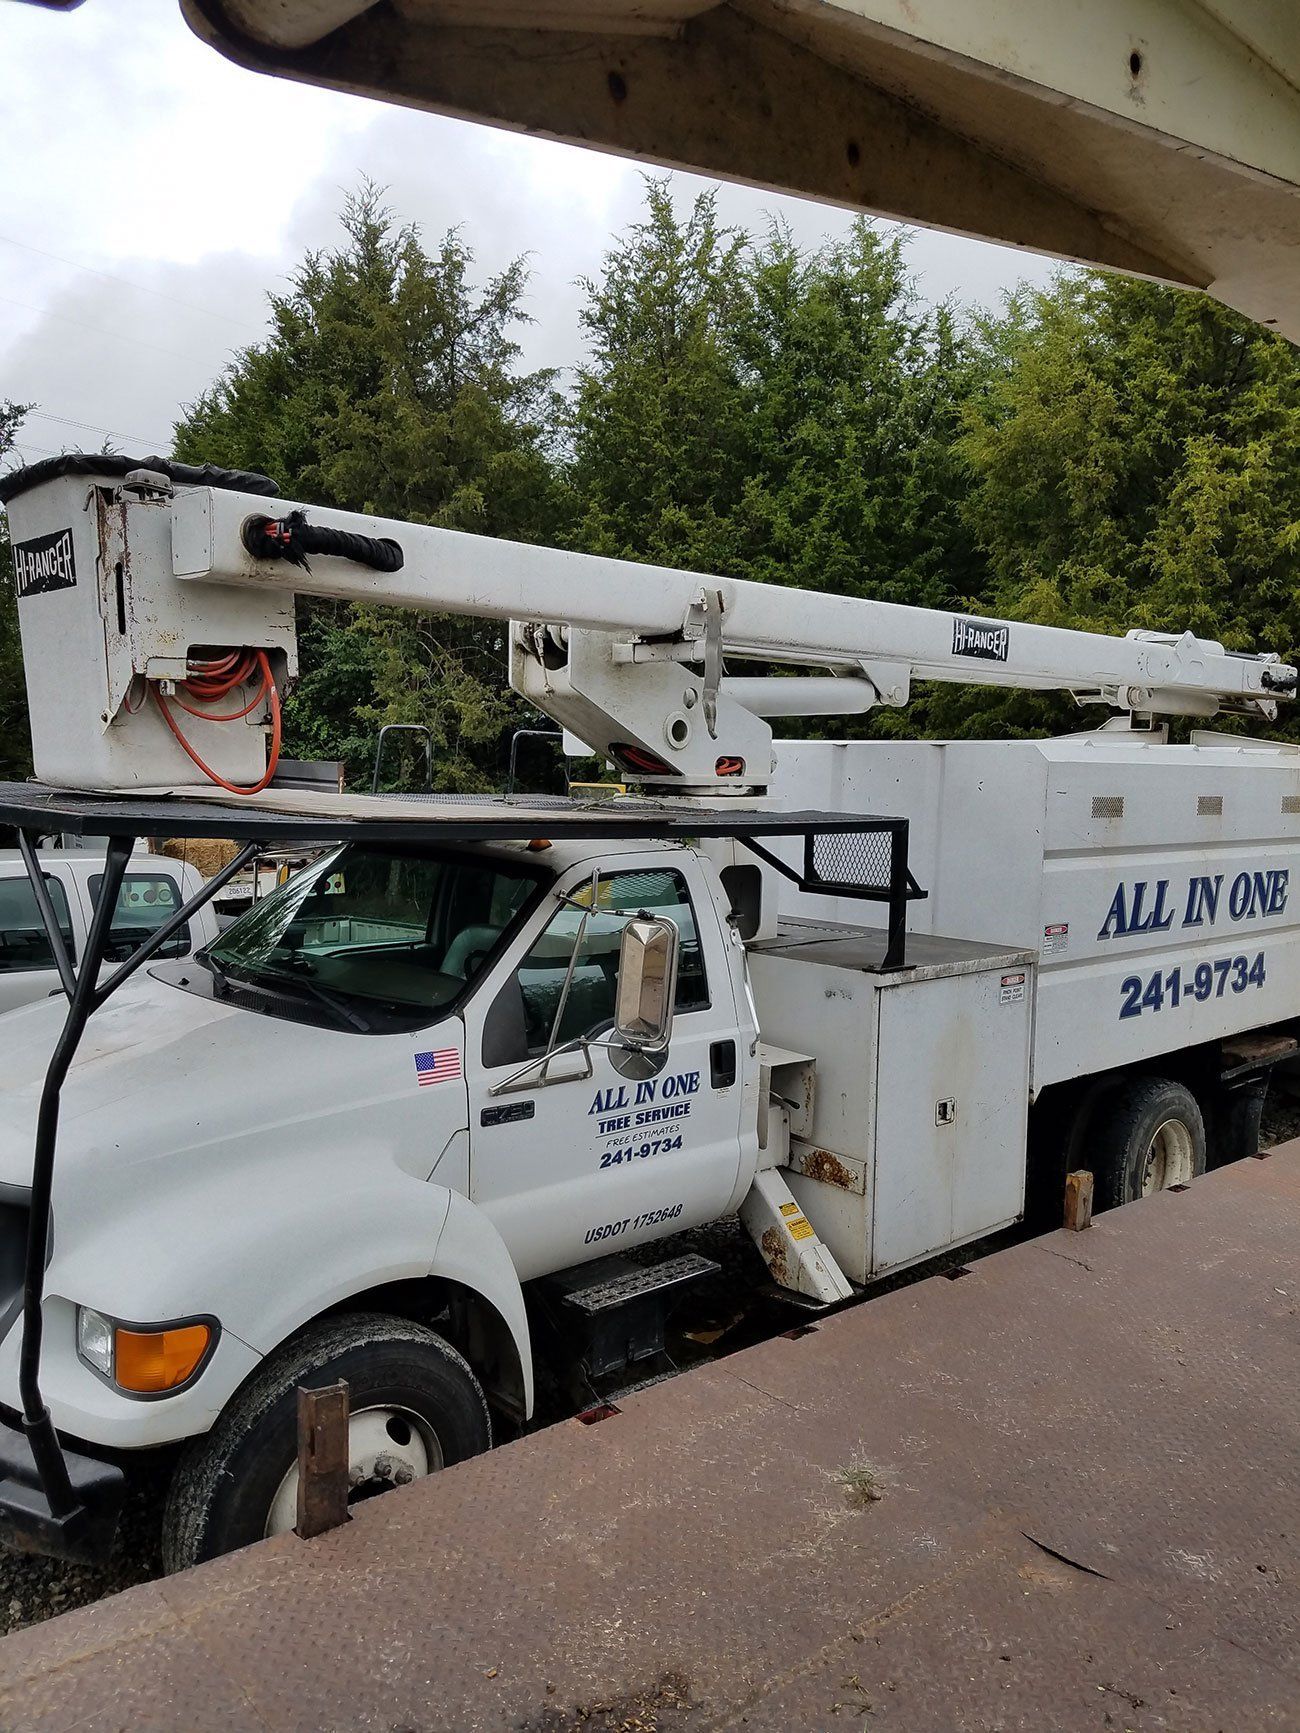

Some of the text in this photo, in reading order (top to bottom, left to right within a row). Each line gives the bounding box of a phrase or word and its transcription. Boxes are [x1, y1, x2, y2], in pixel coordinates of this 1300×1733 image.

[13, 532, 74, 596] HI-RANGER
[954, 619, 1007, 660] HI-RANGER
[1097, 869, 1289, 941] ALL IN ONE
[1119, 951, 1266, 1020] 241-9734
[588, 1085, 630, 1115] ALL
[634, 1079, 658, 1105] IN
[662, 1071, 700, 1099] ONE
[598, 1102, 691, 1134] TREE SERVICE
[606, 1124, 680, 1148] FREE ESTIMATES
[599, 1135, 683, 1169] 241-9734
[584, 1203, 683, 1244] USDOT 1752648
